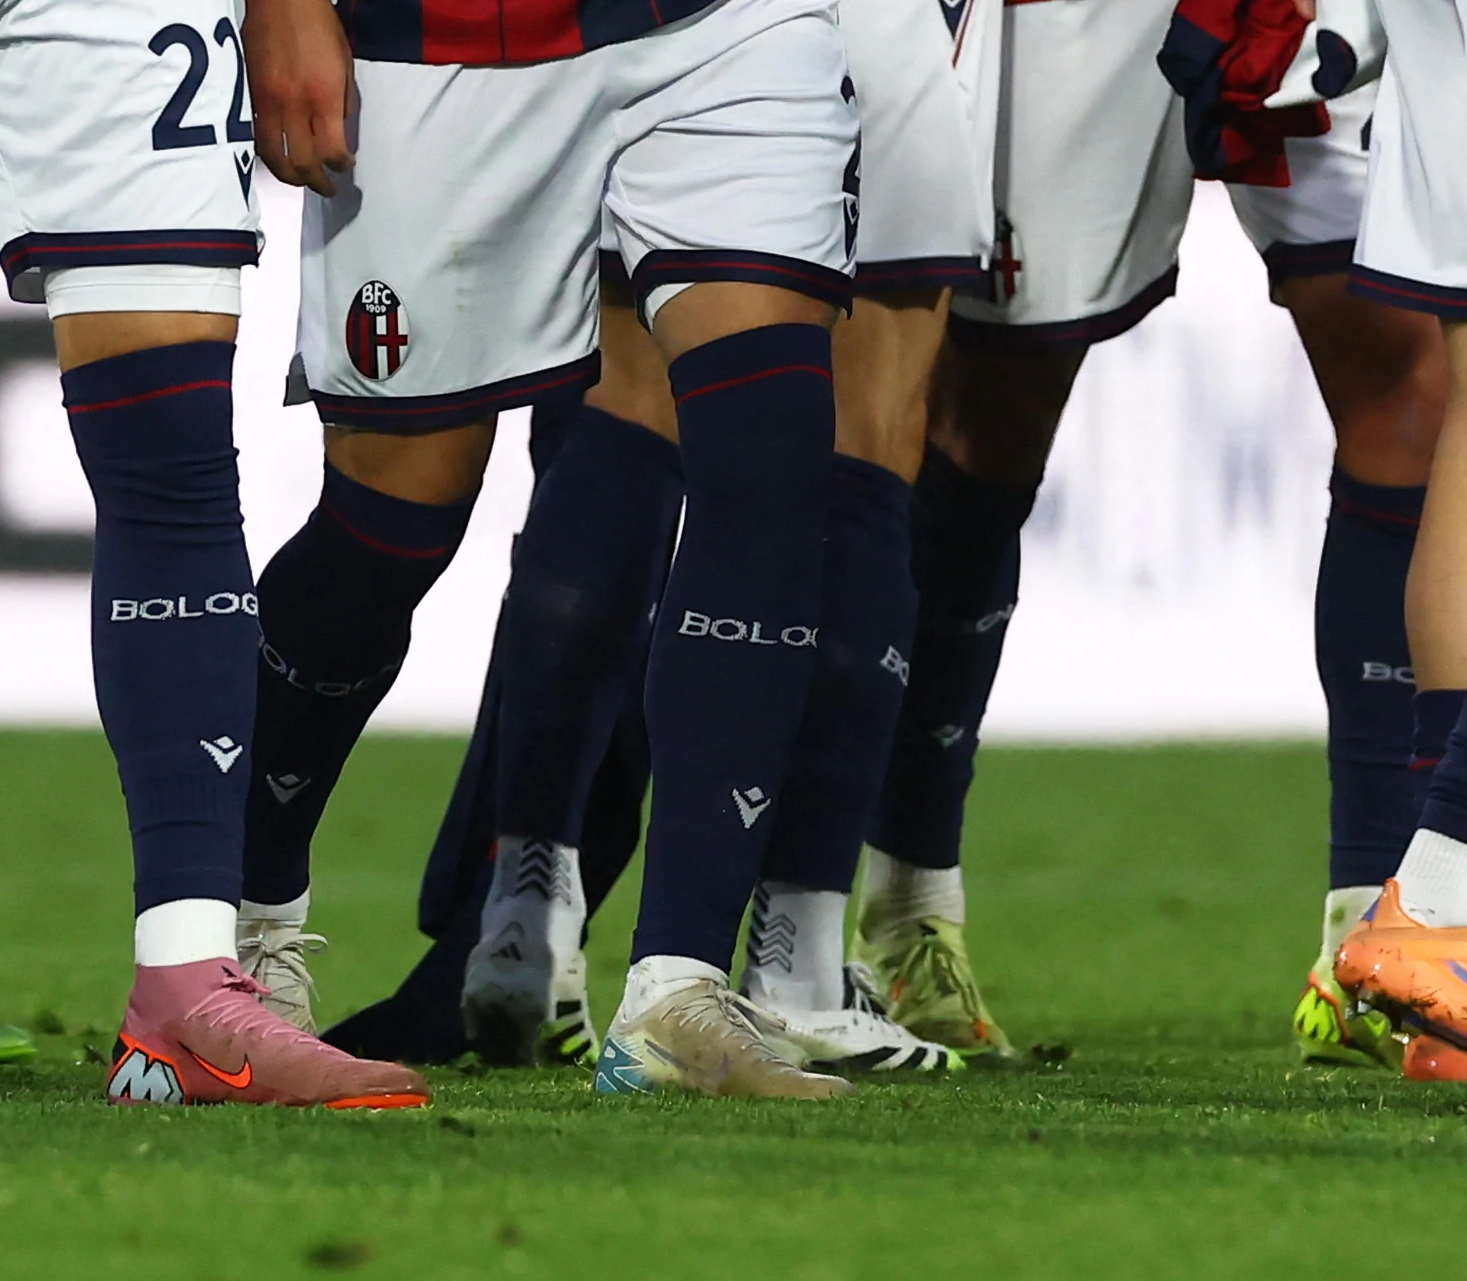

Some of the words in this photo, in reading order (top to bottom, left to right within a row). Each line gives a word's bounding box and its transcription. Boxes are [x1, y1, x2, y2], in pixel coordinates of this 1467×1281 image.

[148, 16, 253, 151] 22
[362, 282, 392, 305] BFC
[365, 303, 387, 313] 1909
